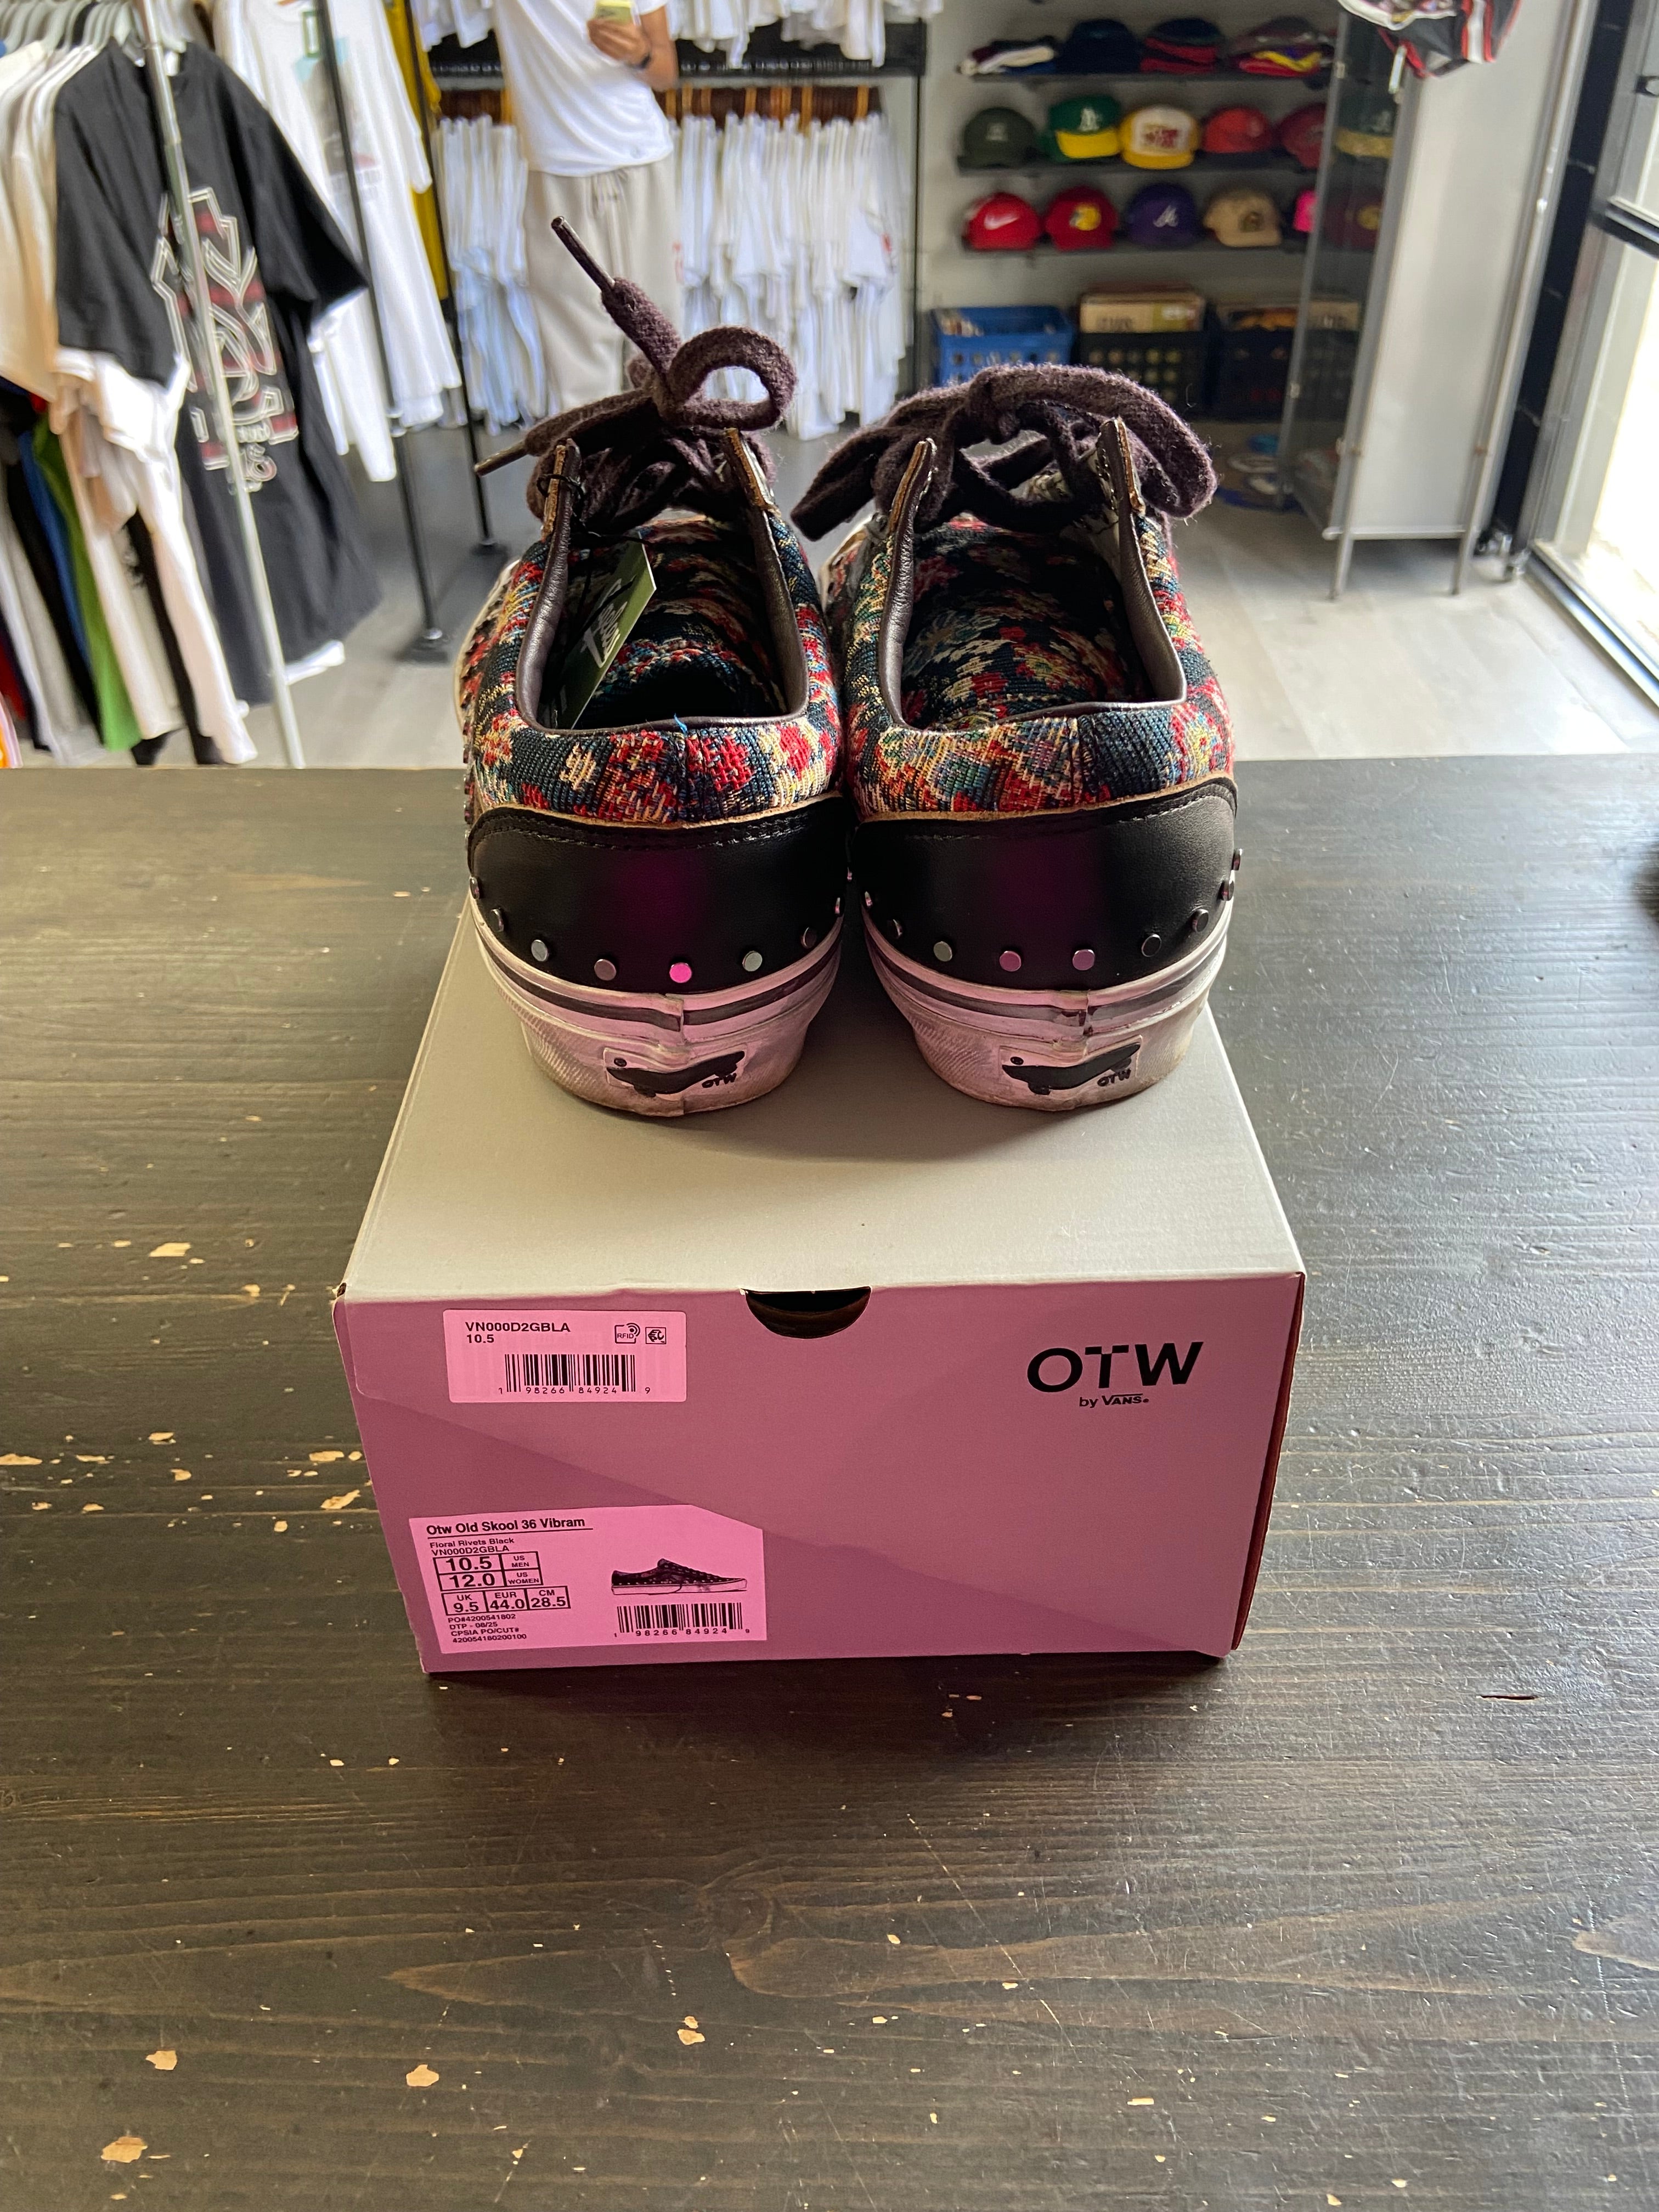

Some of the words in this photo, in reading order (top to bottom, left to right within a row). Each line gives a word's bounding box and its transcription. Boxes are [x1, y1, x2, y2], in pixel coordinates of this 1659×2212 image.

[702, 1073, 737, 1088] OTW
[1097, 1068, 1131, 1086] OTW
[465, 1322, 571, 1332] VN000D2GBLA
[467, 1334, 494, 1343] 10.5
[1027, 1341, 1204, 1392] OTW
[1079, 1397, 1098, 1408] by
[426, 1525, 452, 1535] Otw
[455, 1522, 478, 1533] Old
[482, 1520, 518, 1531] Skool
[521, 1519, 537, 1529] 36
[539, 1519, 585, 1528] Vibram
[430, 1541, 455, 1549] Floral
[431, 1545, 510, 1556] VN000D2GBLA
[445, 1556, 492, 1571] 10.5
[449, 1573, 495, 1588] 12.0
[453, 1601, 479, 1612] 9.5
[490, 1598, 525, 1610] 44.0
[531, 1596, 566, 1608] 28.5
[448, 1613, 516, 1623] PO#4200541802
